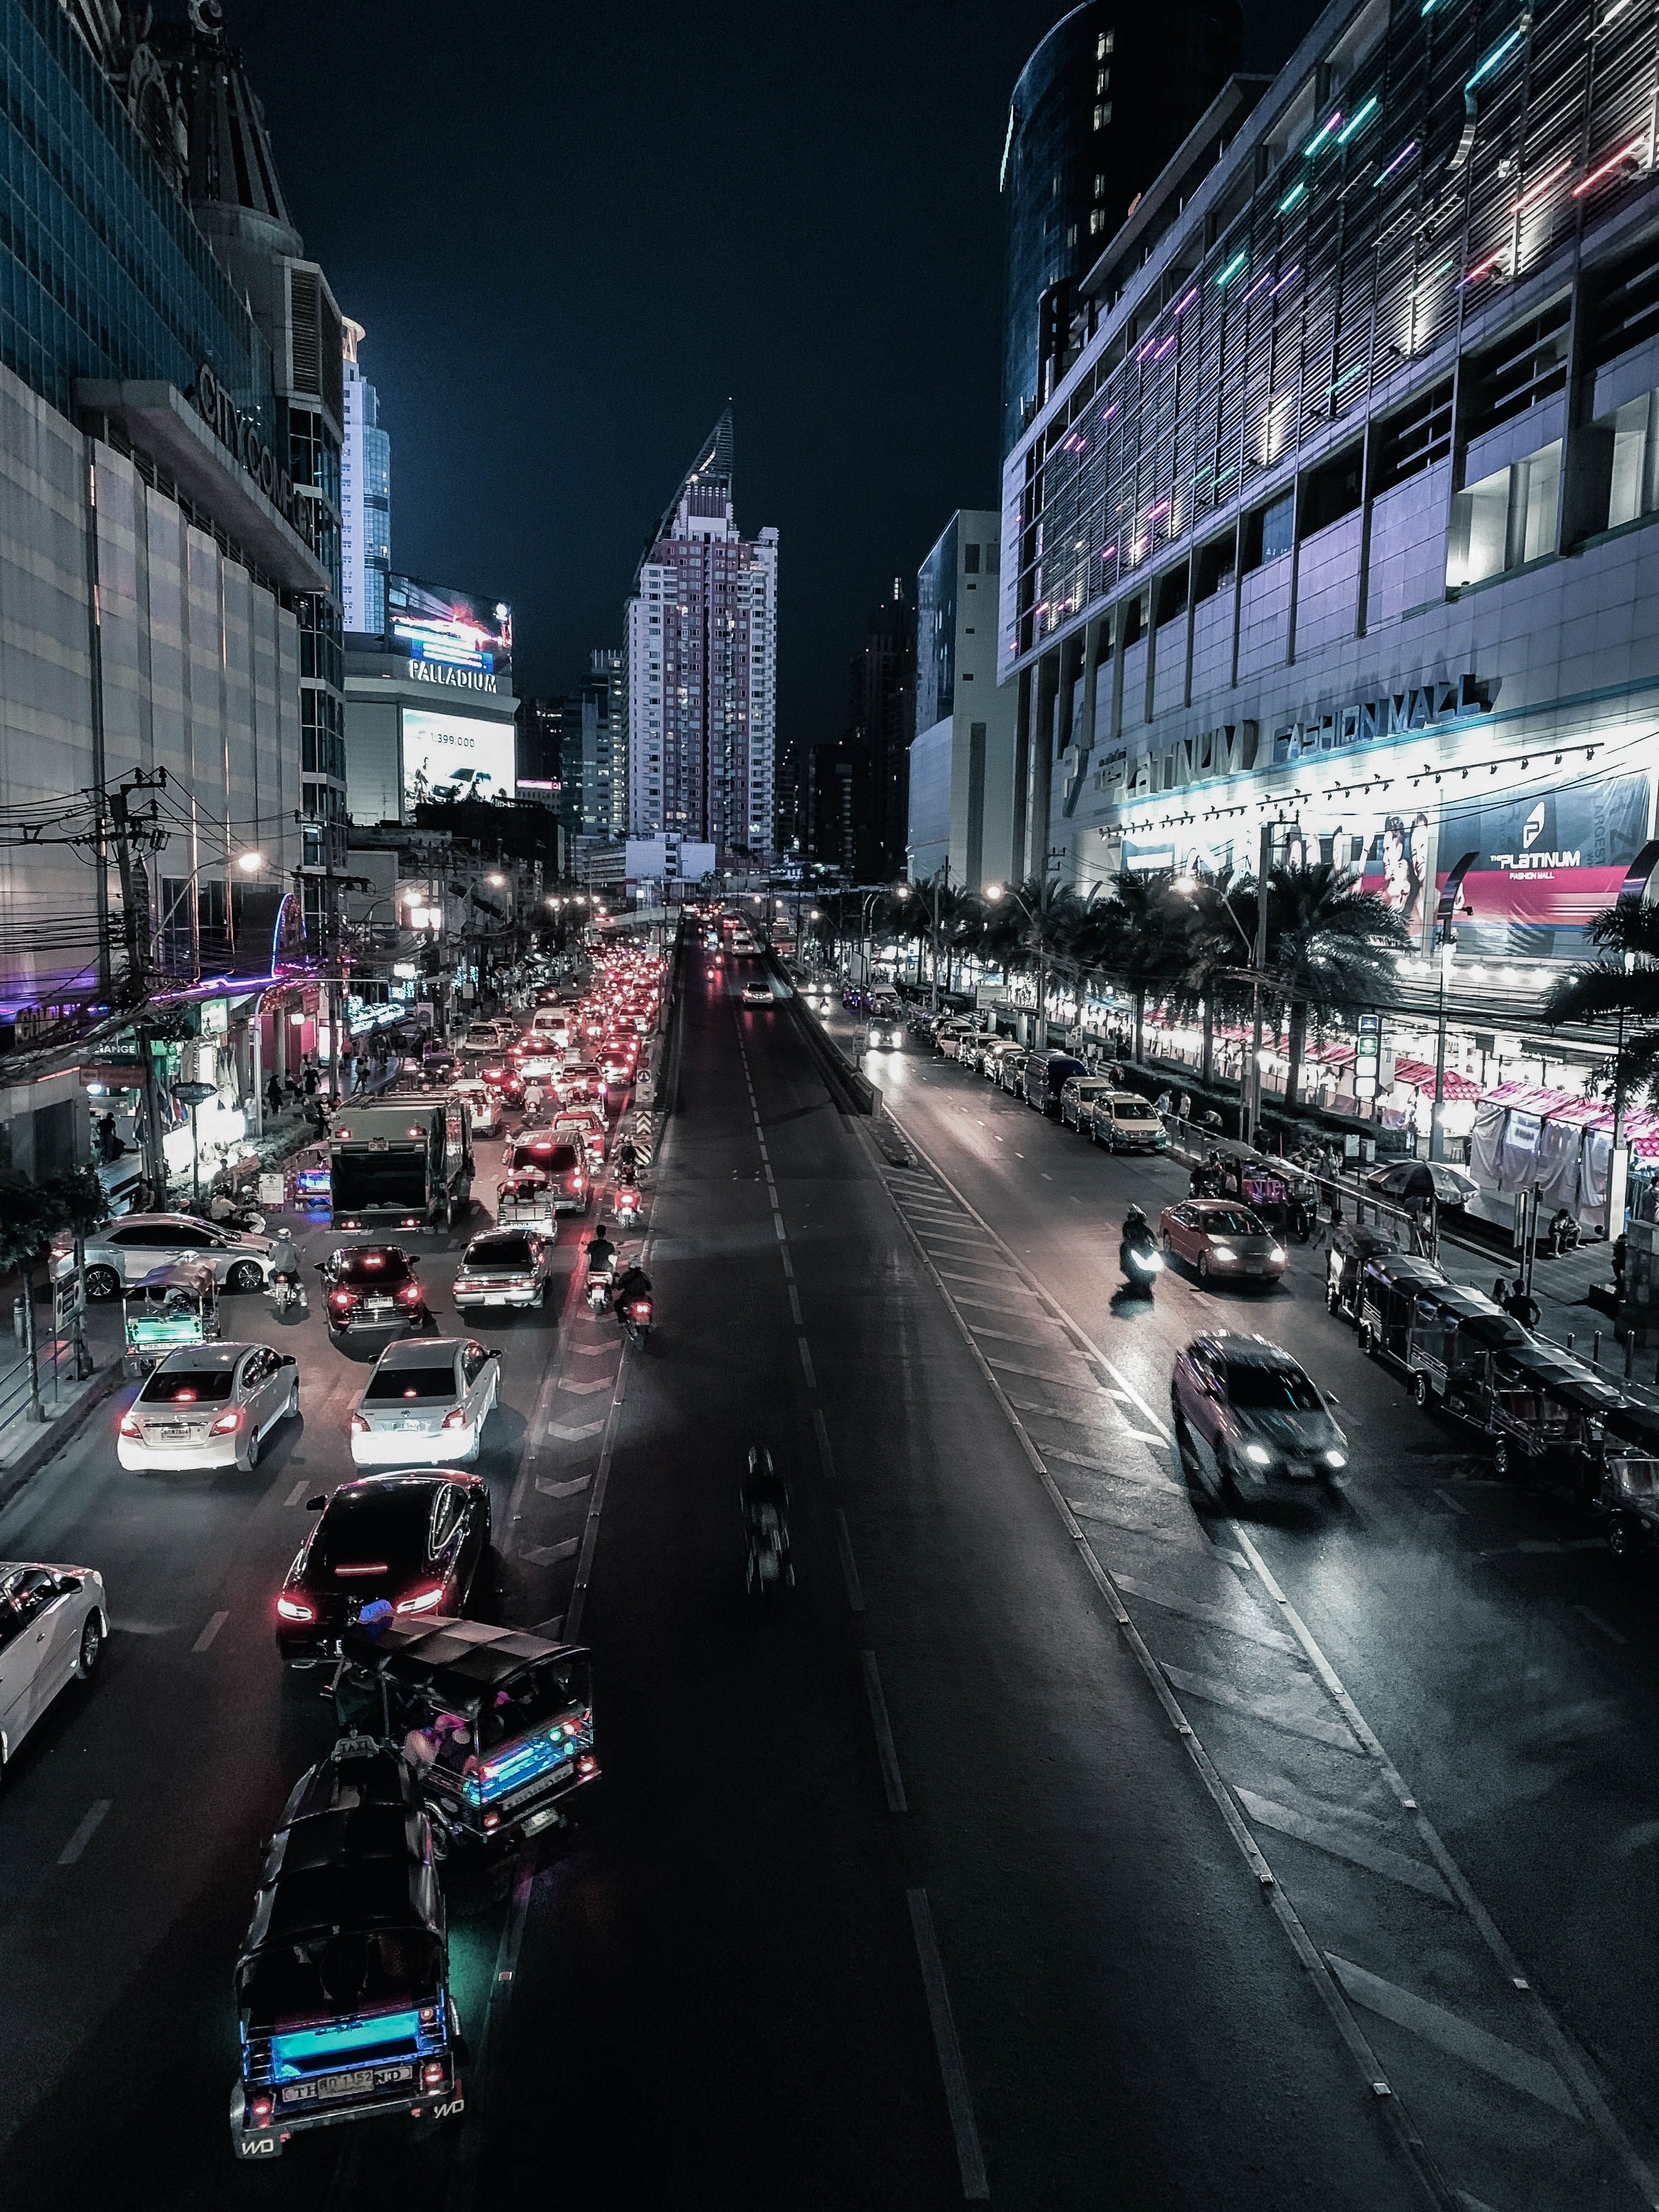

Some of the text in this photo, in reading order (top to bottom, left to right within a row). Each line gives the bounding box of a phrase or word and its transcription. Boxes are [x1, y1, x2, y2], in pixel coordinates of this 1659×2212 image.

[409, 659, 496, 693] PALLADIUM
[1273, 699, 1389, 764] FASHION
[1389, 674, 1481, 734] MALL
[1254, 1181, 1281, 1196] VIP
